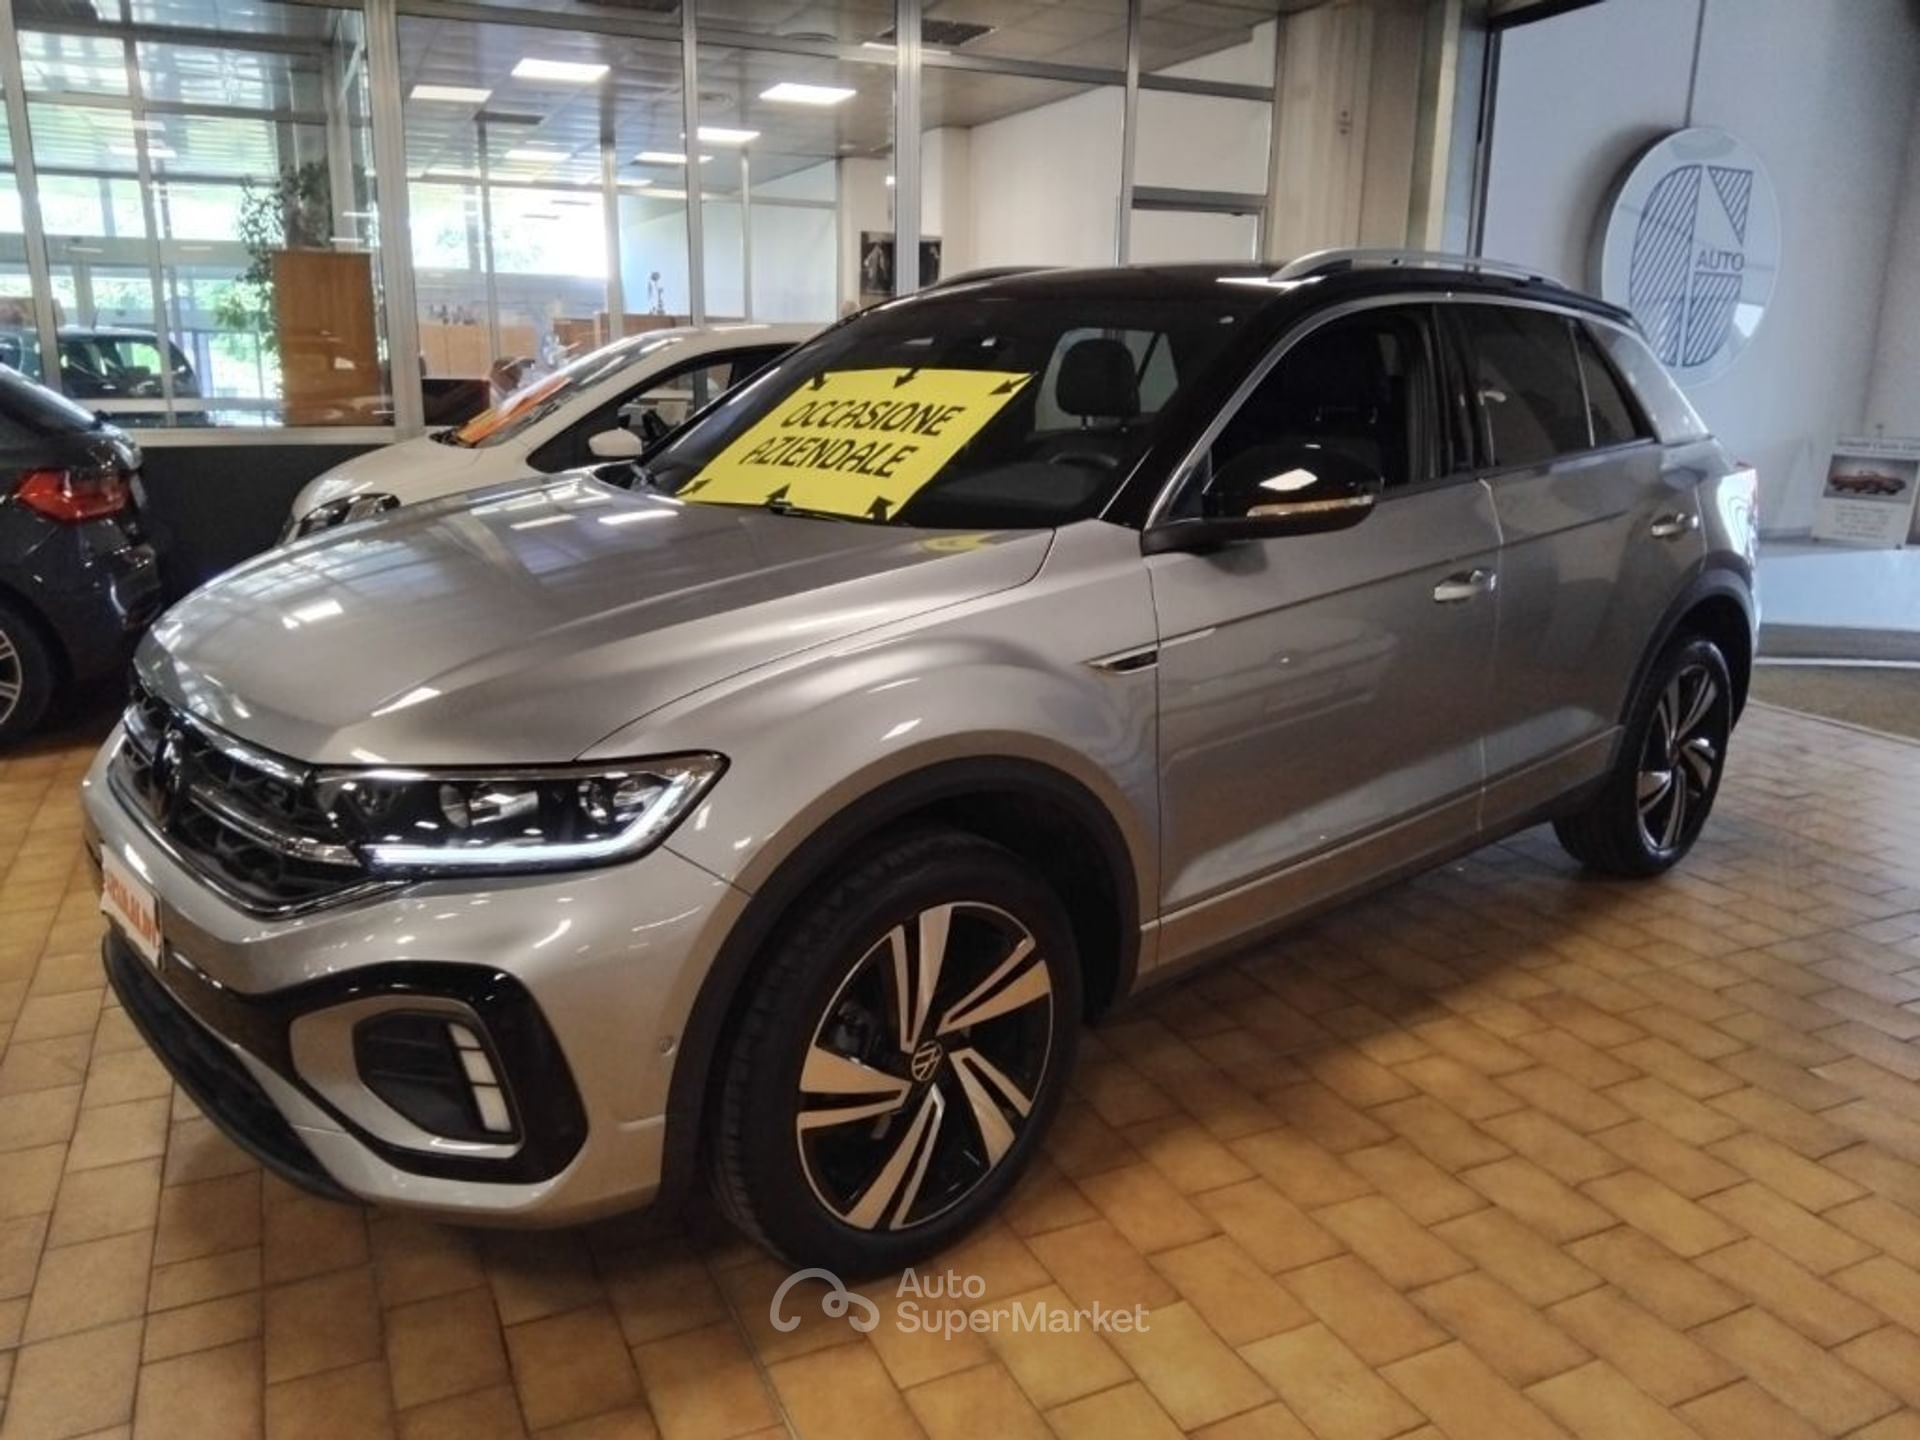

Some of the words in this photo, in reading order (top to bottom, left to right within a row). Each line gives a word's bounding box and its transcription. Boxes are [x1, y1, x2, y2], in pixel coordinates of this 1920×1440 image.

[1695, 250, 1745, 271] AUTO
[781, 400, 967, 436] OCCASIONE
[738, 436, 919, 478] AZIENDALE
